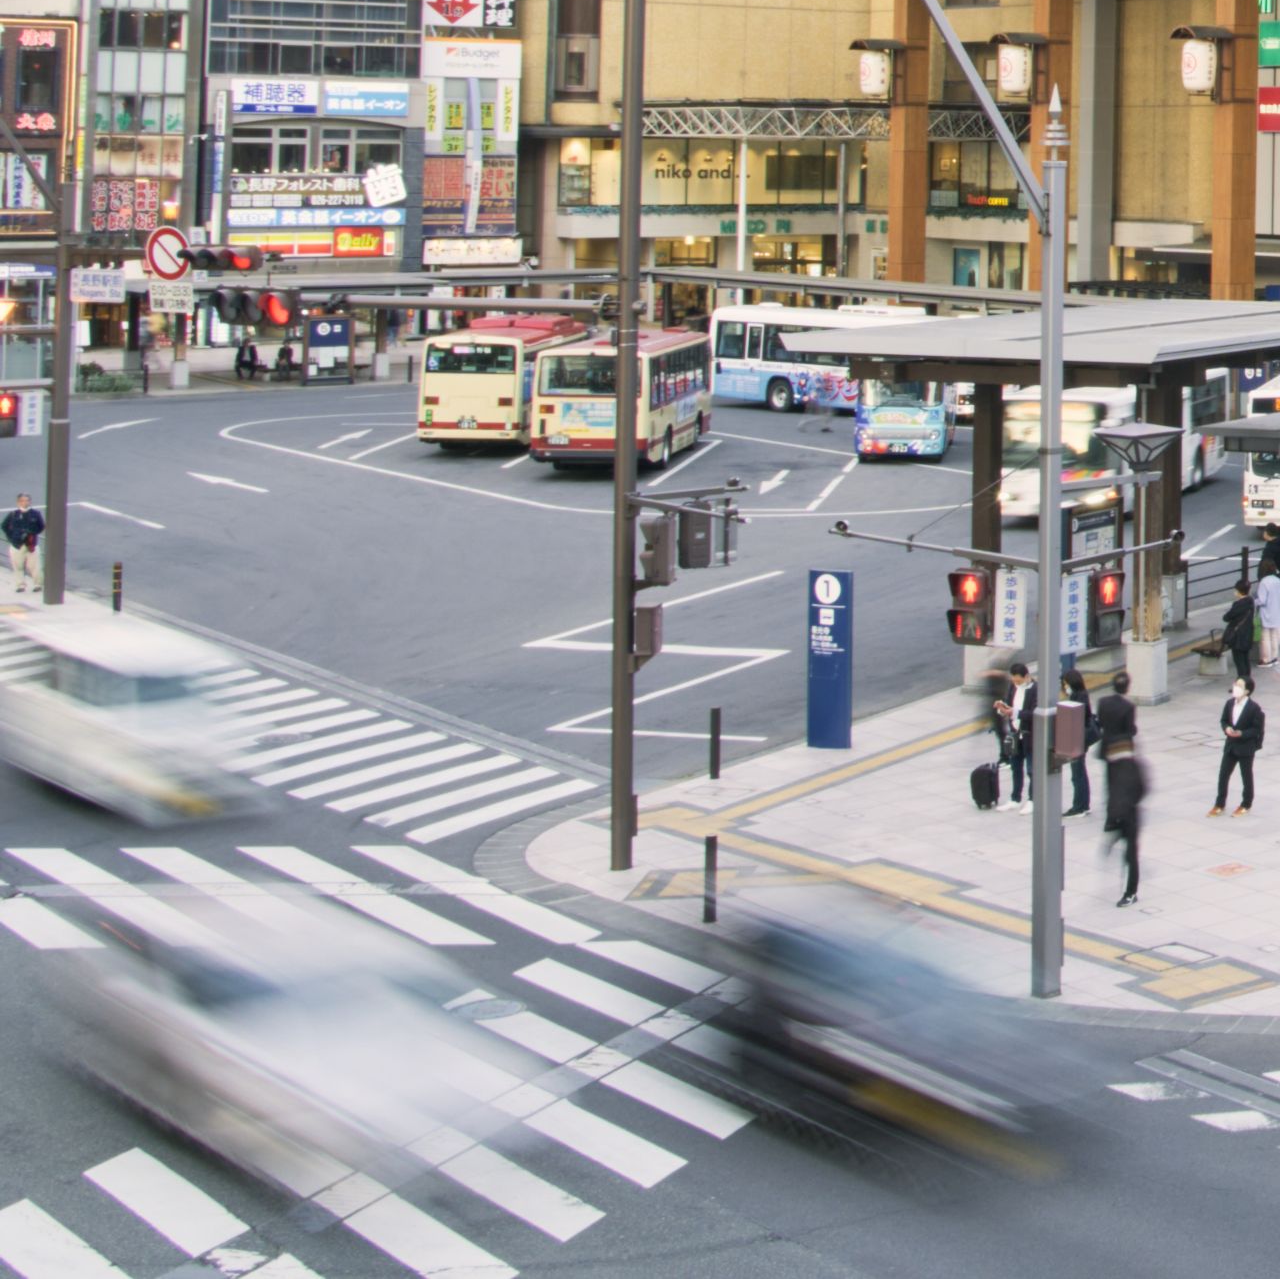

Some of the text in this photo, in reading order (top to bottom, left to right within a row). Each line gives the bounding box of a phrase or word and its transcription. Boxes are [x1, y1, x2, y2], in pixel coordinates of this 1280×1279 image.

[461, 47, 500, 61] Budget
[244, 83, 306, 103] 補聴器
[655, 164, 692, 179] niko
[697, 164, 732, 179] and
[249, 177, 360, 192] 長野フォレスト歯科
[988, 196, 1009, 206] COFFEE
[1004, 576, 1017, 643] 歩車分離式
[1067, 580, 1080, 647] 歩車分離式
